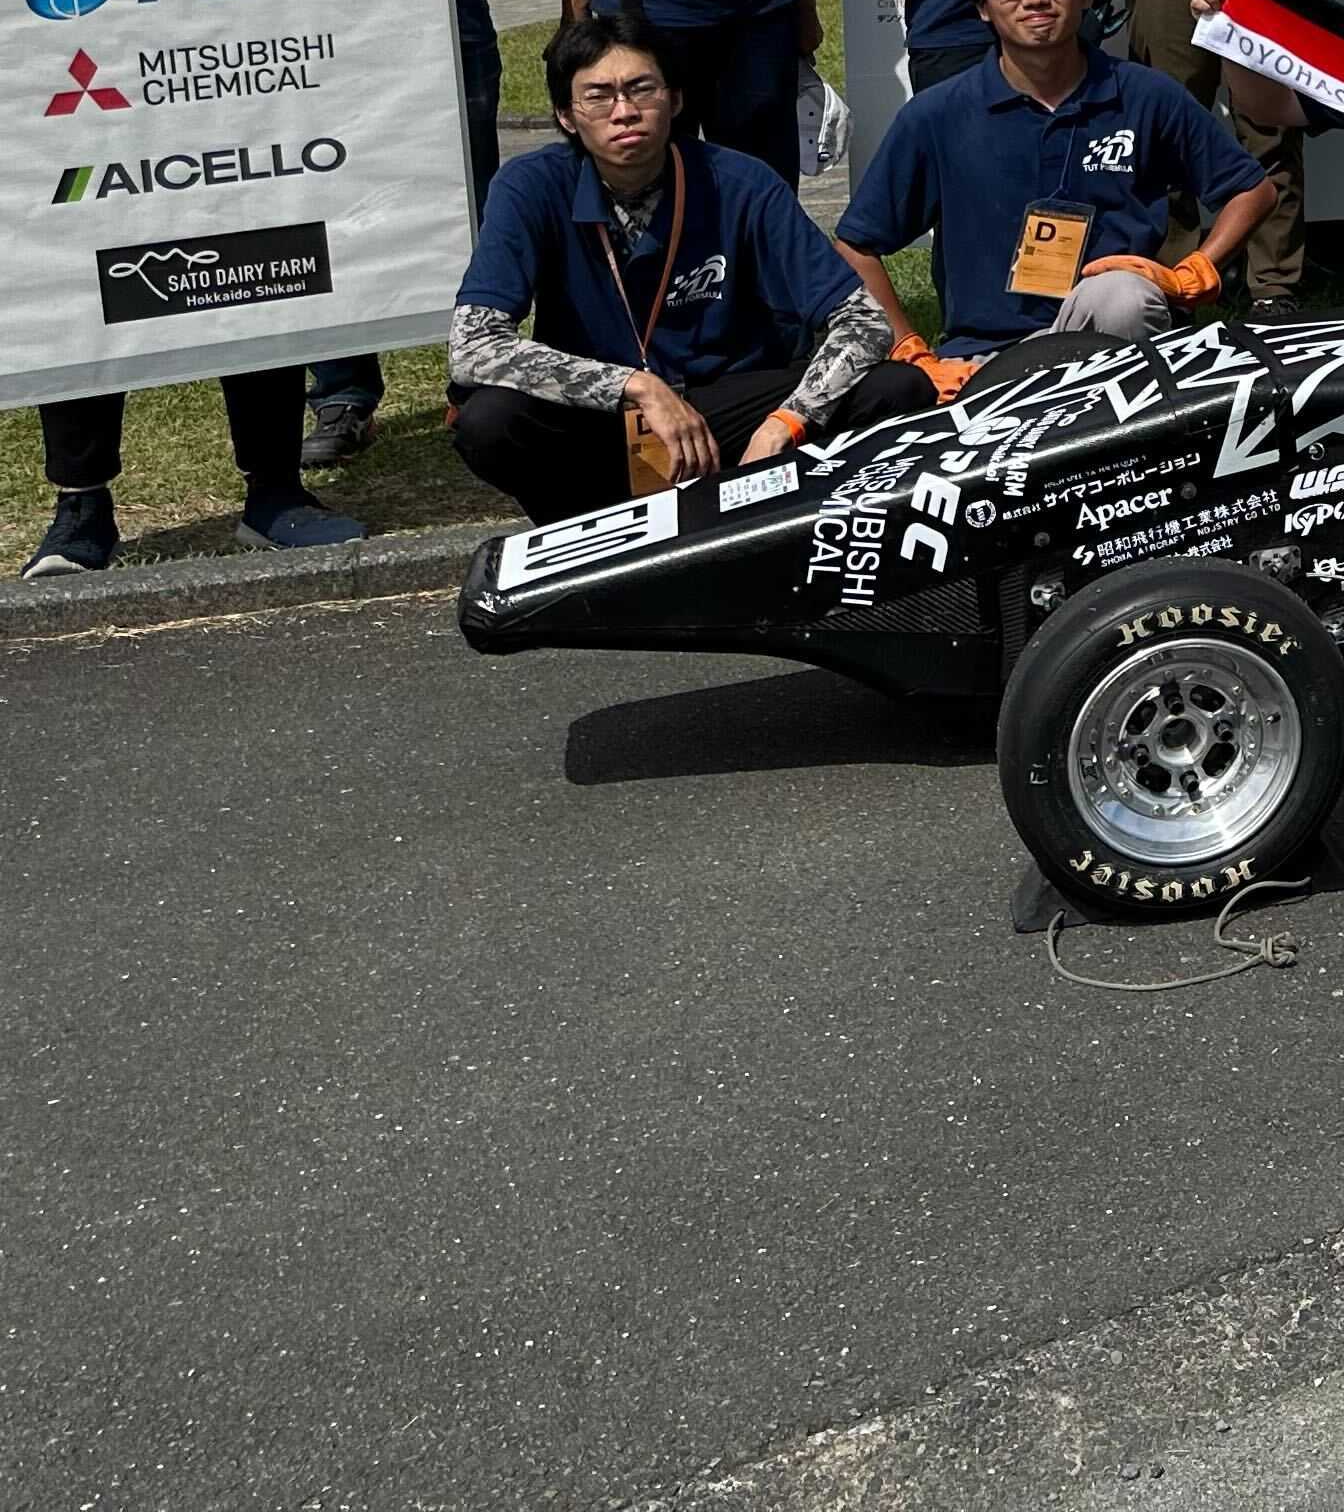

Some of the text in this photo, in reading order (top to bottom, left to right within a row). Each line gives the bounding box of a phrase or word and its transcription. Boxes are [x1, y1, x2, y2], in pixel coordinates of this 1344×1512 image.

[138, 33, 336, 78] MITSUBISHI
[143, 63, 321, 106] CHEMICAL
[95, 137, 347, 200] AICELLO
[1034, 221, 1057, 242] D
[167, 255, 317, 293] SATO DAIRY FARM
[186, 287, 252, 308] Hokkaido
[1074, 487, 1173, 532] Apacer
